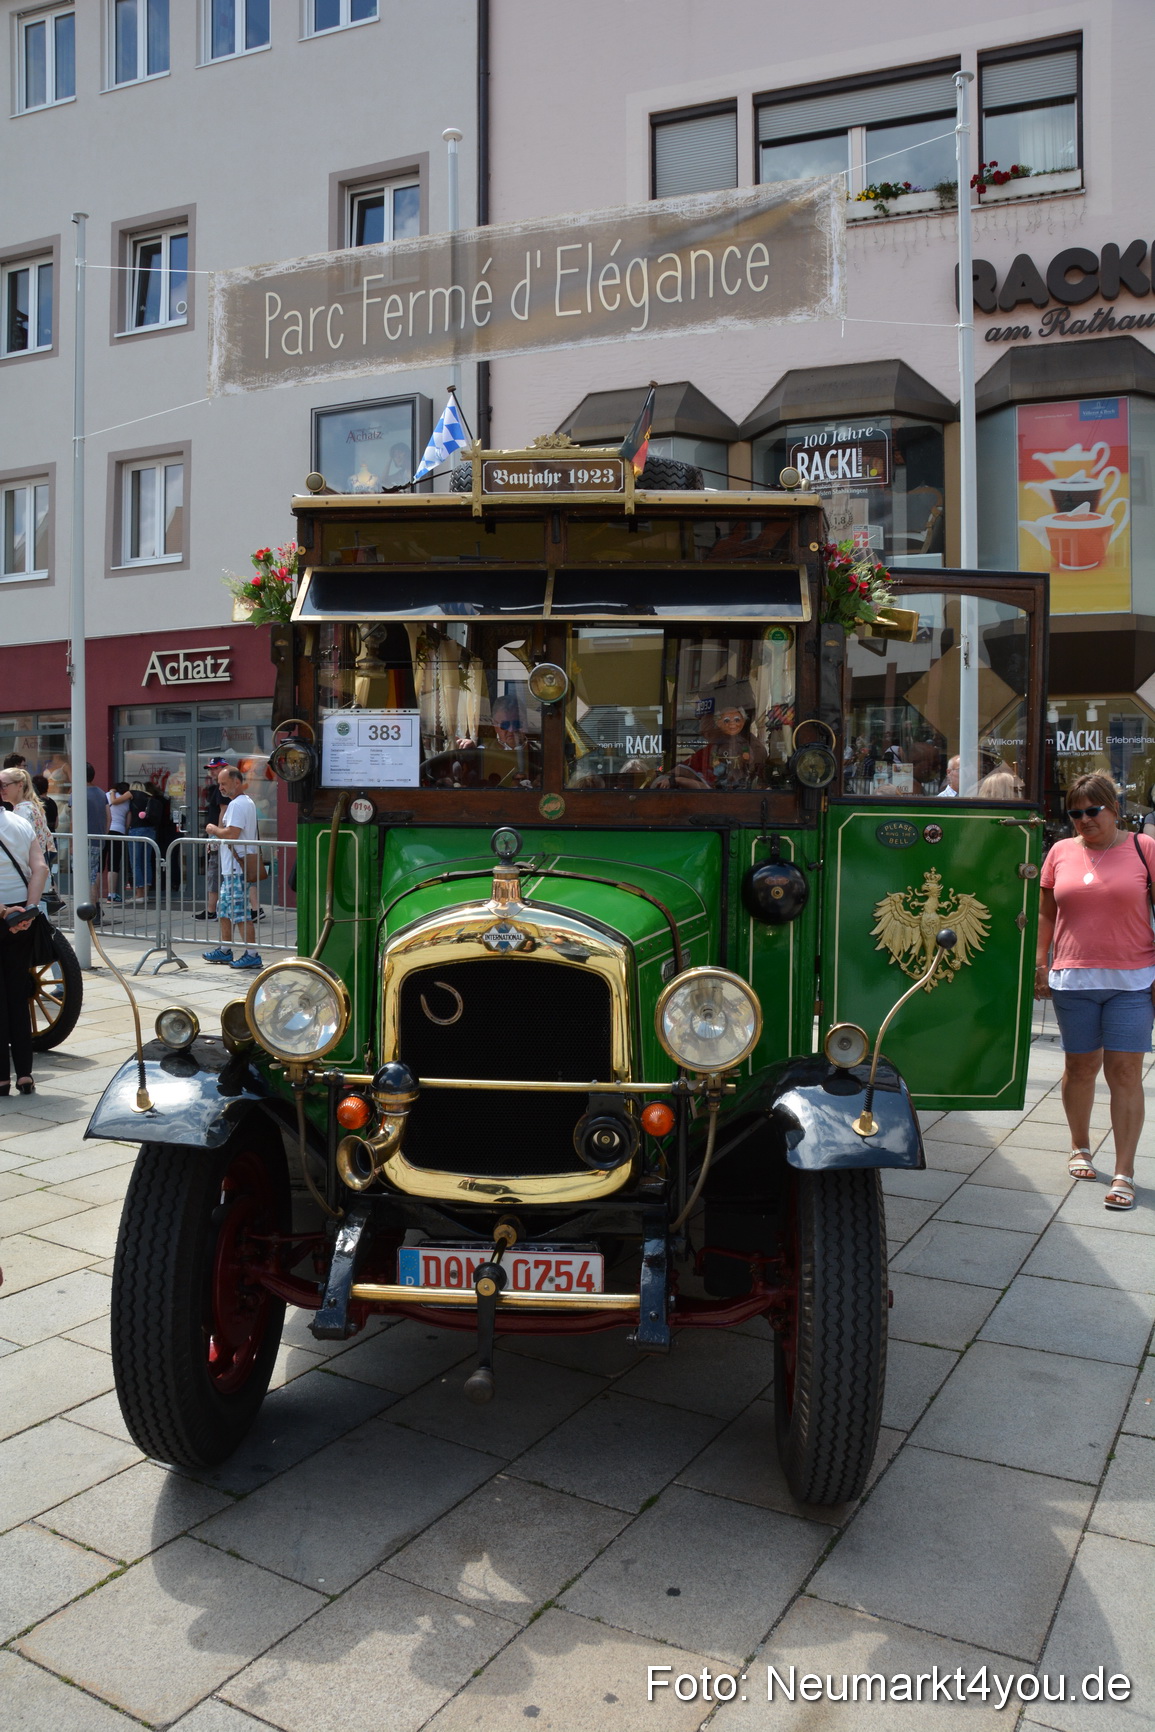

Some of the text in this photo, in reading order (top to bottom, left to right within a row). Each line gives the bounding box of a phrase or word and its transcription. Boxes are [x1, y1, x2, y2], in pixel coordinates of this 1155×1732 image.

[954, 239, 1155, 314] RACK
[265, 238, 770, 360] Parc Fermé d'Elégance
[984, 324, 1032, 343] am
[802, 426, 874, 449] 100 Jahre
[797, 447, 863, 480] RACKL
[492, 468, 615, 488] Baujahr 1923
[141, 647, 231, 687] Achatz
[368, 725, 401, 741] 383
[1057, 730, 1103, 751] RACKL
[884, 823, 913, 832] PLEASE
[888, 837, 909, 845] BELL
[405, 1275, 415, 1286] D
[512, 1258, 595, 1293] 0754
